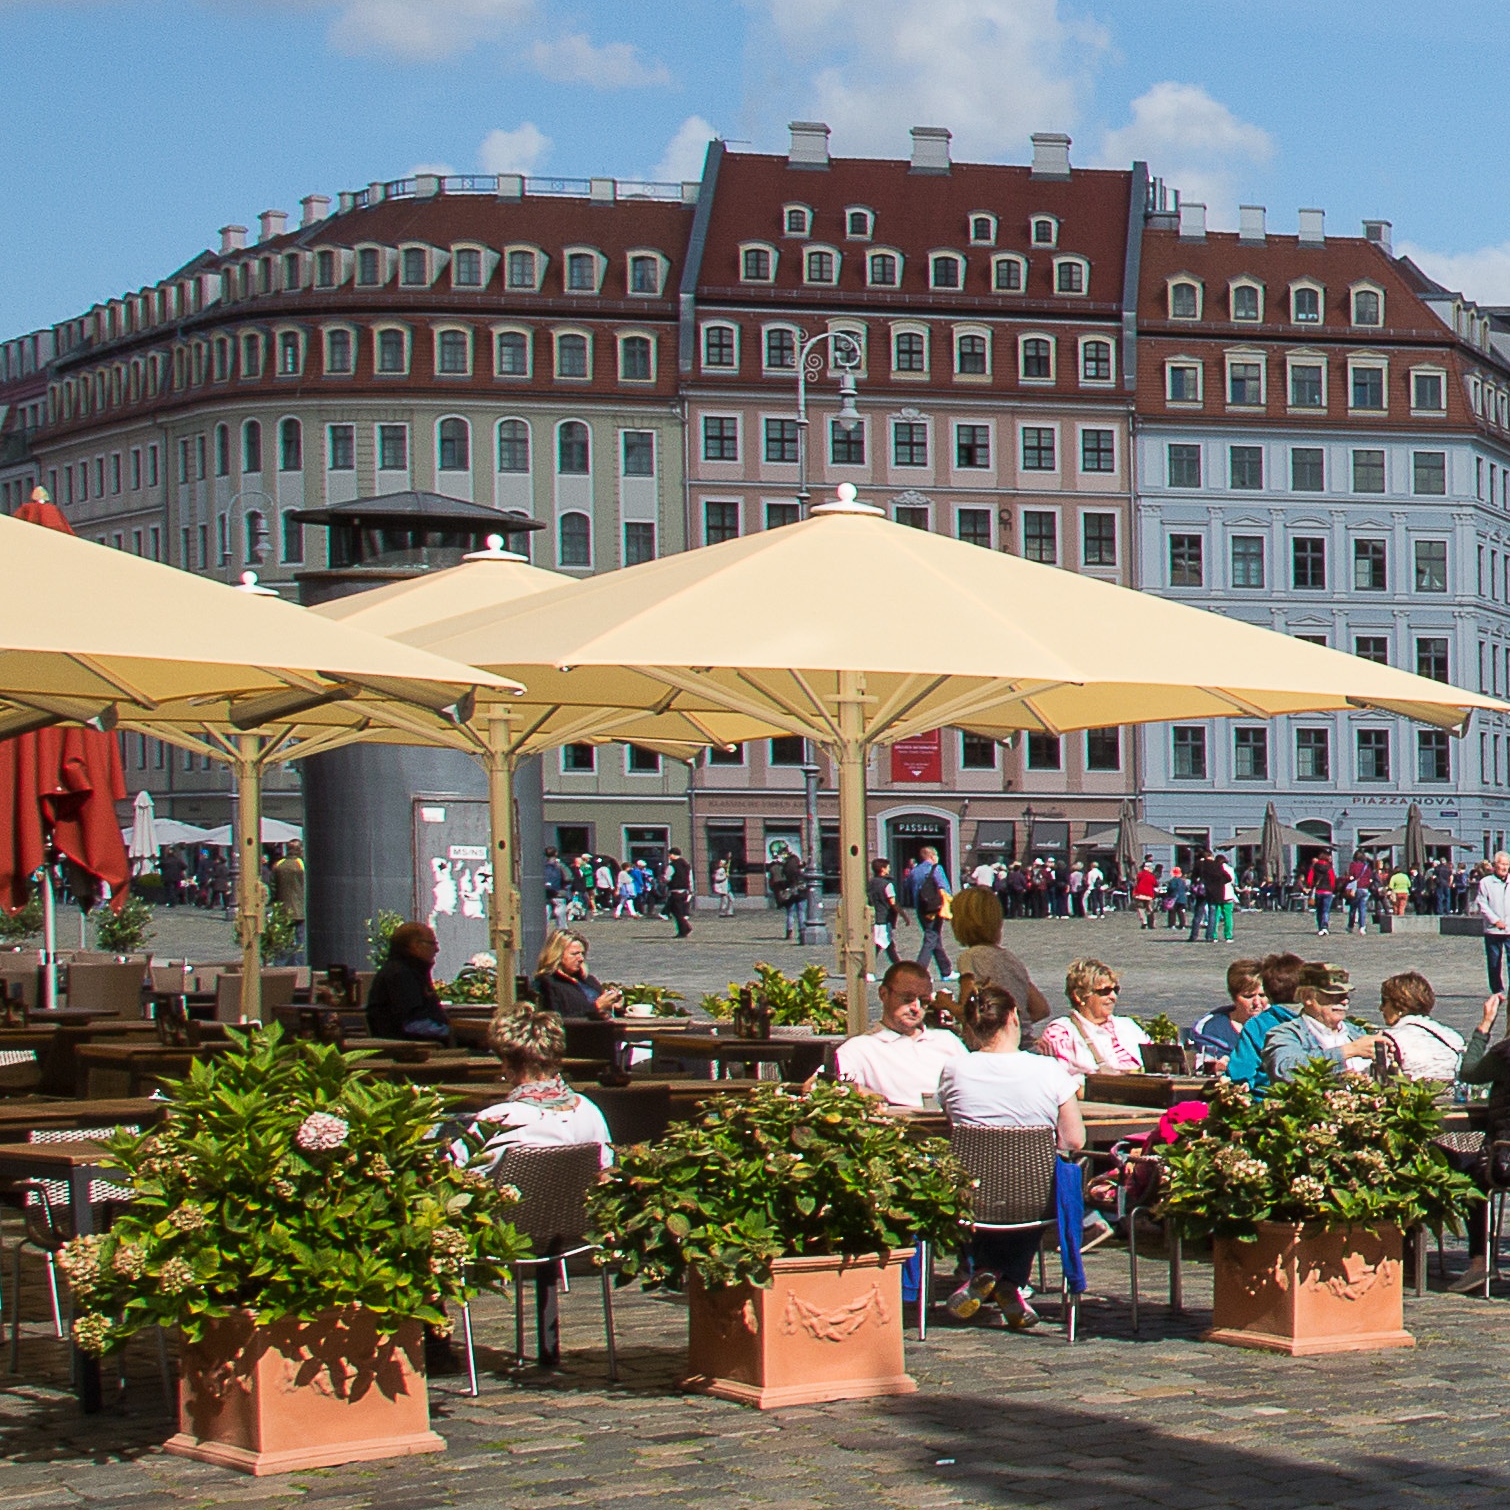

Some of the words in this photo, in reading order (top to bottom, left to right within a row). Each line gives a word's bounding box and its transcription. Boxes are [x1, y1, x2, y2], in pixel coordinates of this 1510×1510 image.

[1353, 797, 1408, 805] PIAZZA
[1412, 797, 1455, 806] NOVA
[899, 823, 939, 833] PASSAGE
